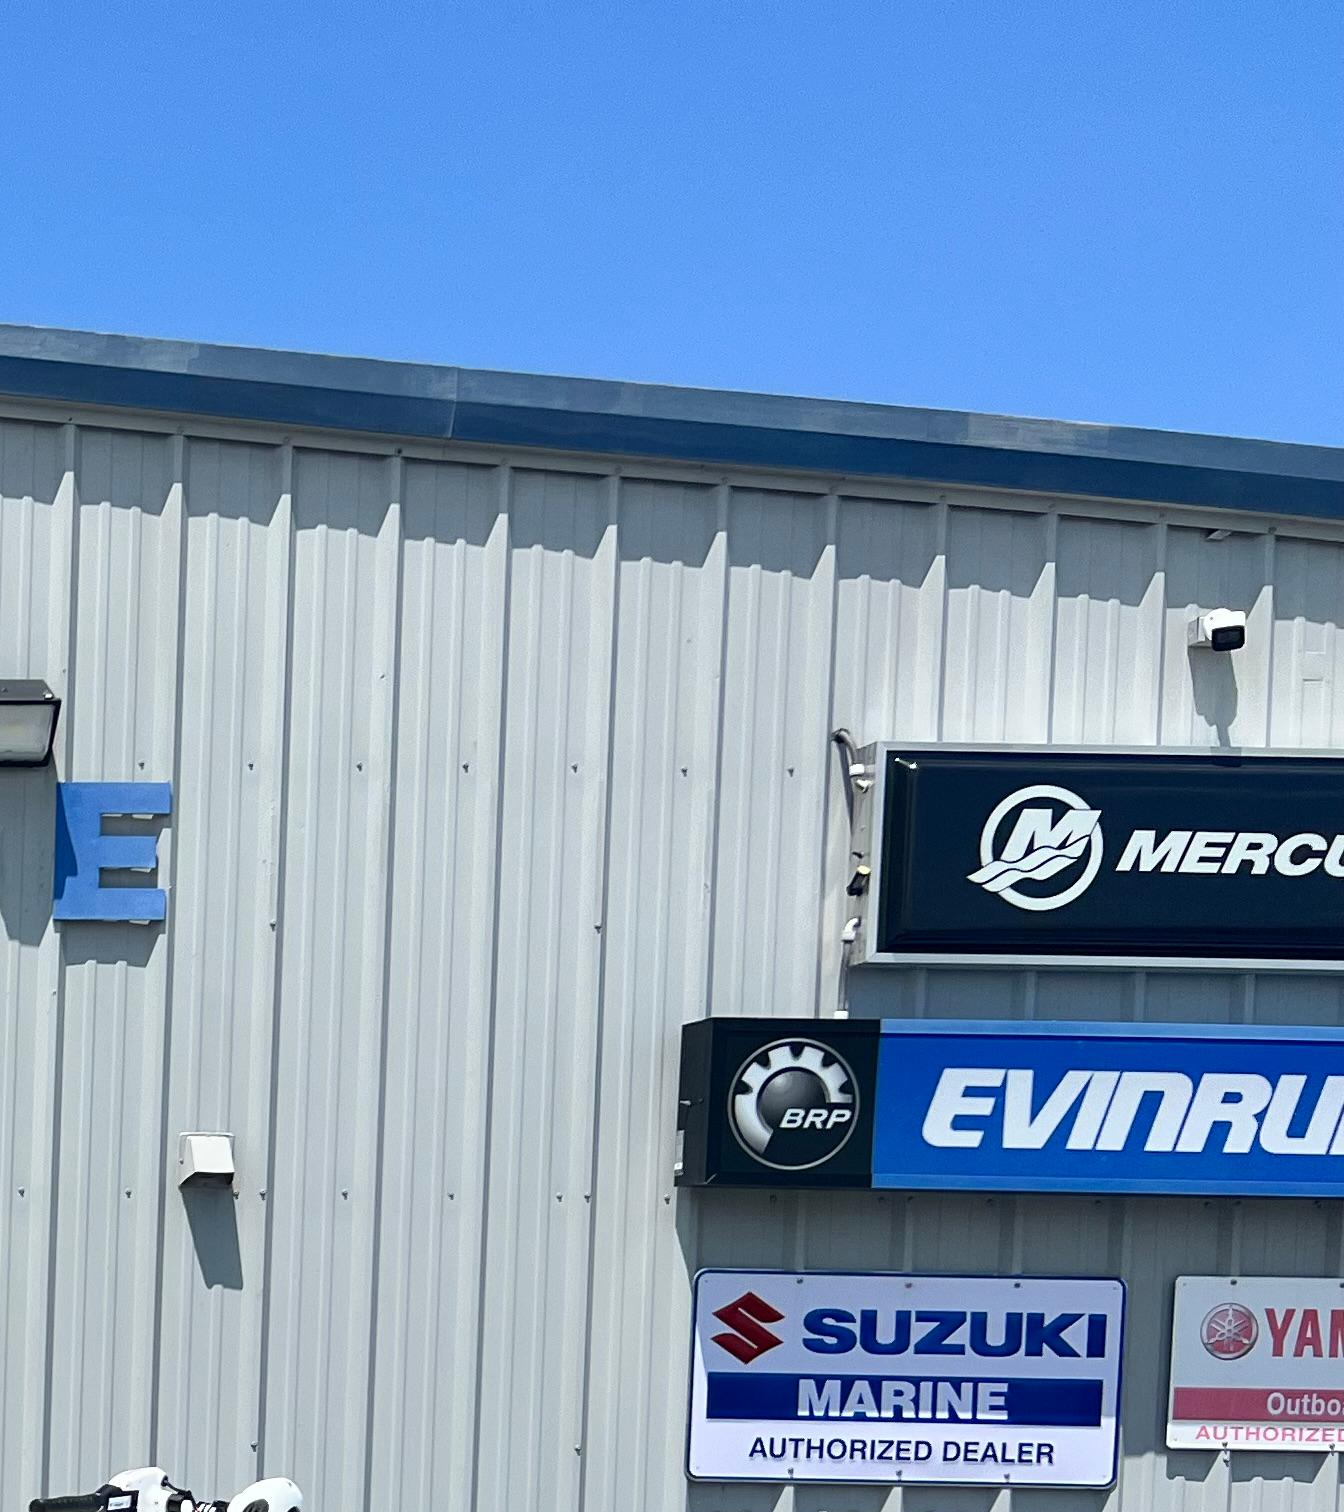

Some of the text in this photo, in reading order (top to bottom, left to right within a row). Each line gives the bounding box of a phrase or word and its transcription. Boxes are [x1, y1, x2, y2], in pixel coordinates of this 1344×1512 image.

[779, 1107, 853, 1130] BRP
[921, 1066, 1344, 1156] EVINRU
[802, 1308, 1107, 1359] SUZUKI
[797, 1378, 1009, 1421] MARINE
[1266, 1392, 1344, 1416] Outbo
[749, 1436, 1055, 1465] AUTHORIZED DEALER
